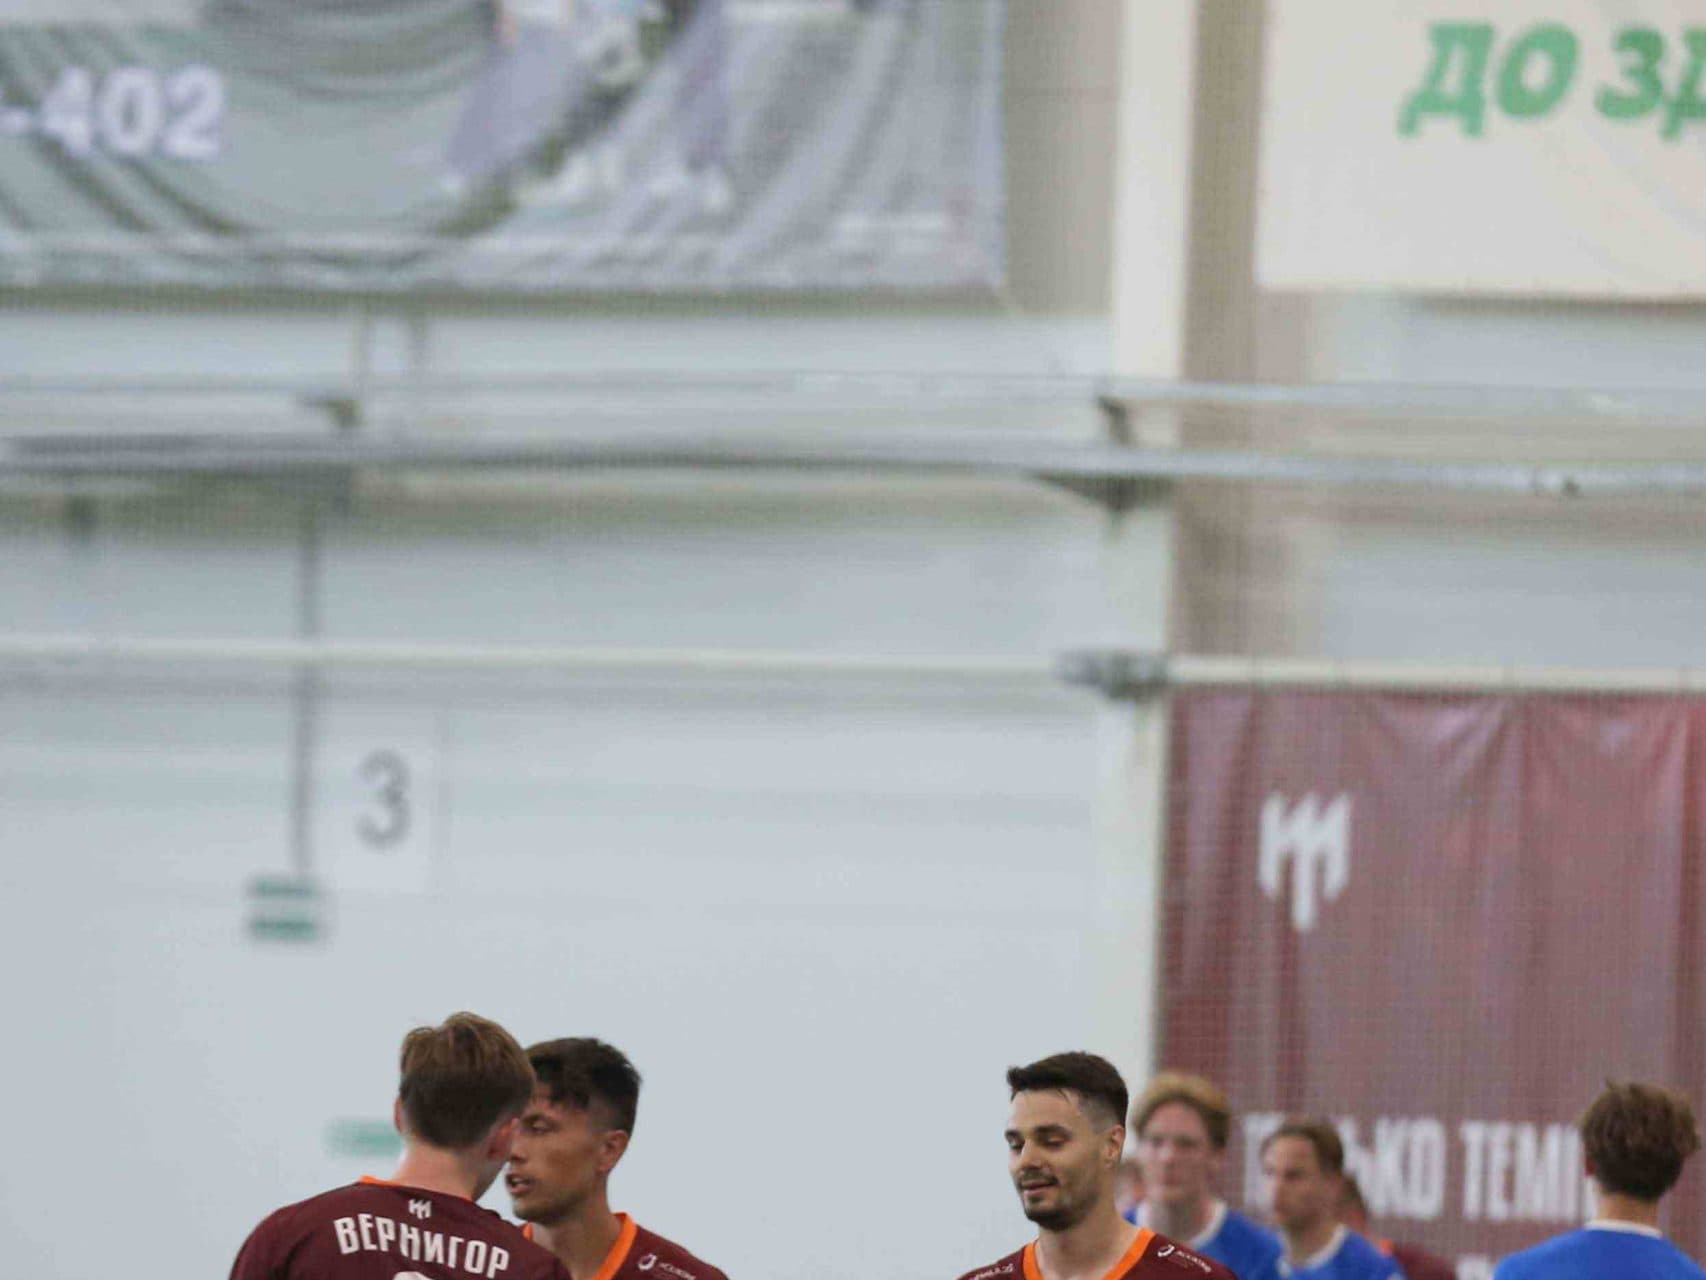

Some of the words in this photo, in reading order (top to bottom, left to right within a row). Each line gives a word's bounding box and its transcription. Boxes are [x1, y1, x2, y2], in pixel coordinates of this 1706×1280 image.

[1395, 20, 1579, 139] ДО
[357, 748, 411, 851] 3
[333, 1213, 511, 1280] ВЕРНИГОР
